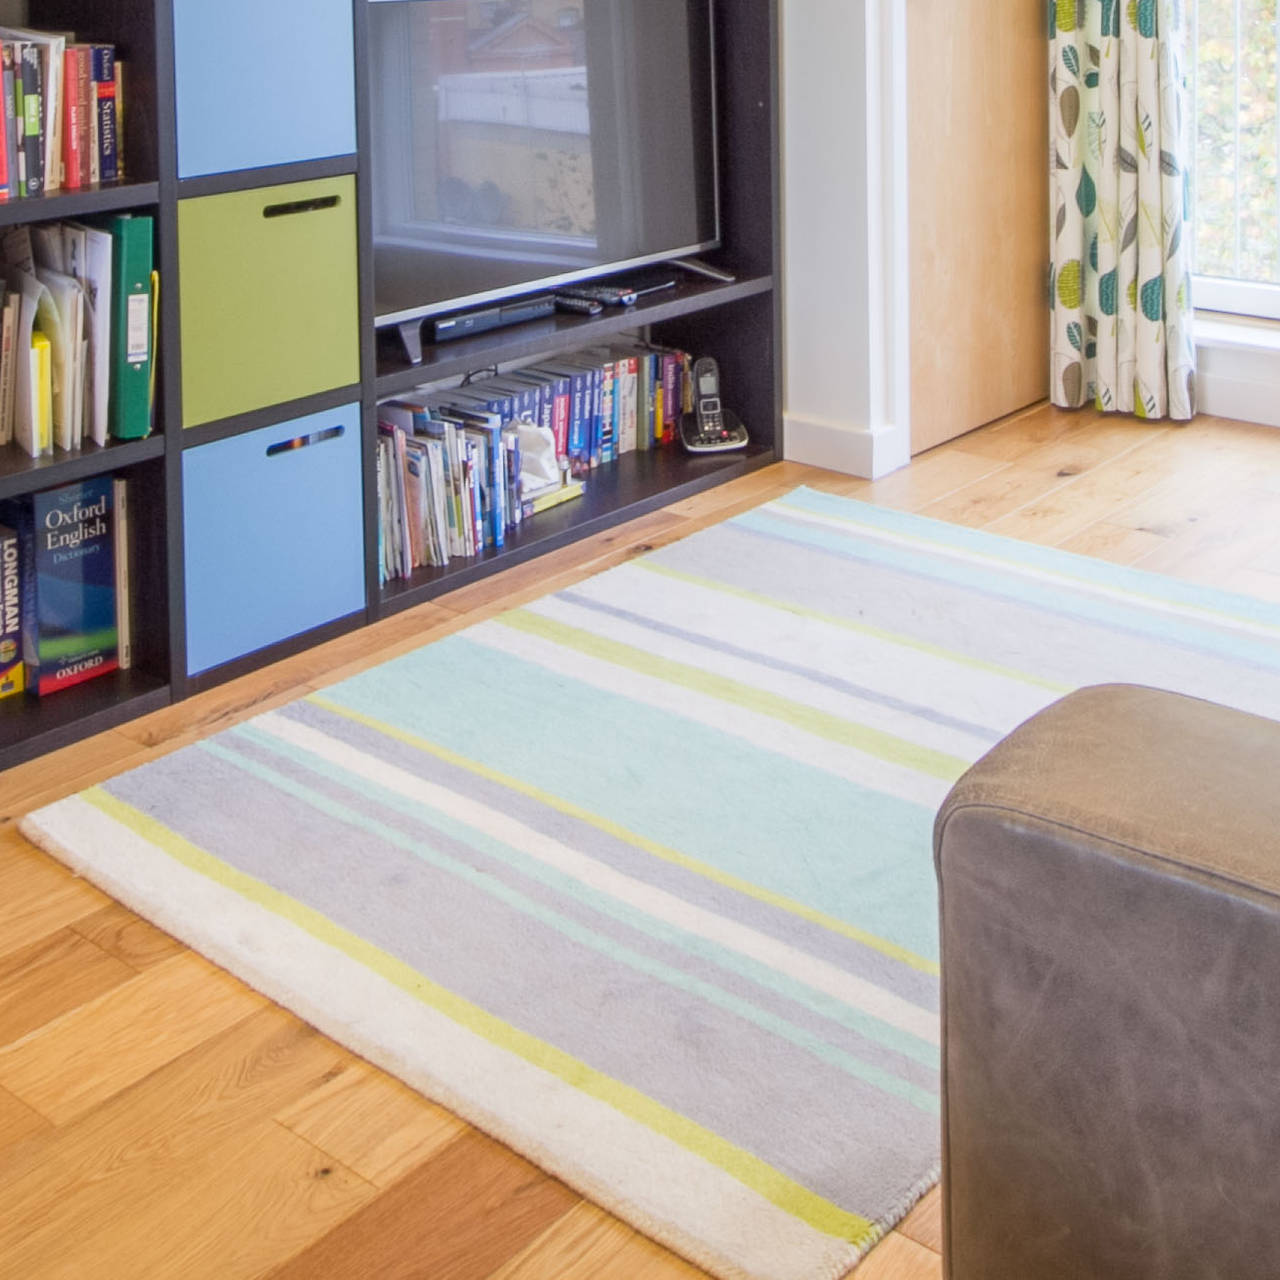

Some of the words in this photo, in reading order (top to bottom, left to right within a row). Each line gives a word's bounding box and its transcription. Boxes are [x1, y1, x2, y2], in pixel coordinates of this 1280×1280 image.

[77, 52, 87, 77] good
[102, 49, 111, 81] Oxford
[101, 101, 114, 156] Statistics
[44, 495, 107, 530] Oxford
[46, 517, 107, 551] English
[3, 538, 19, 634] LONGMAN
[56, 655, 104, 680] OXFORD
